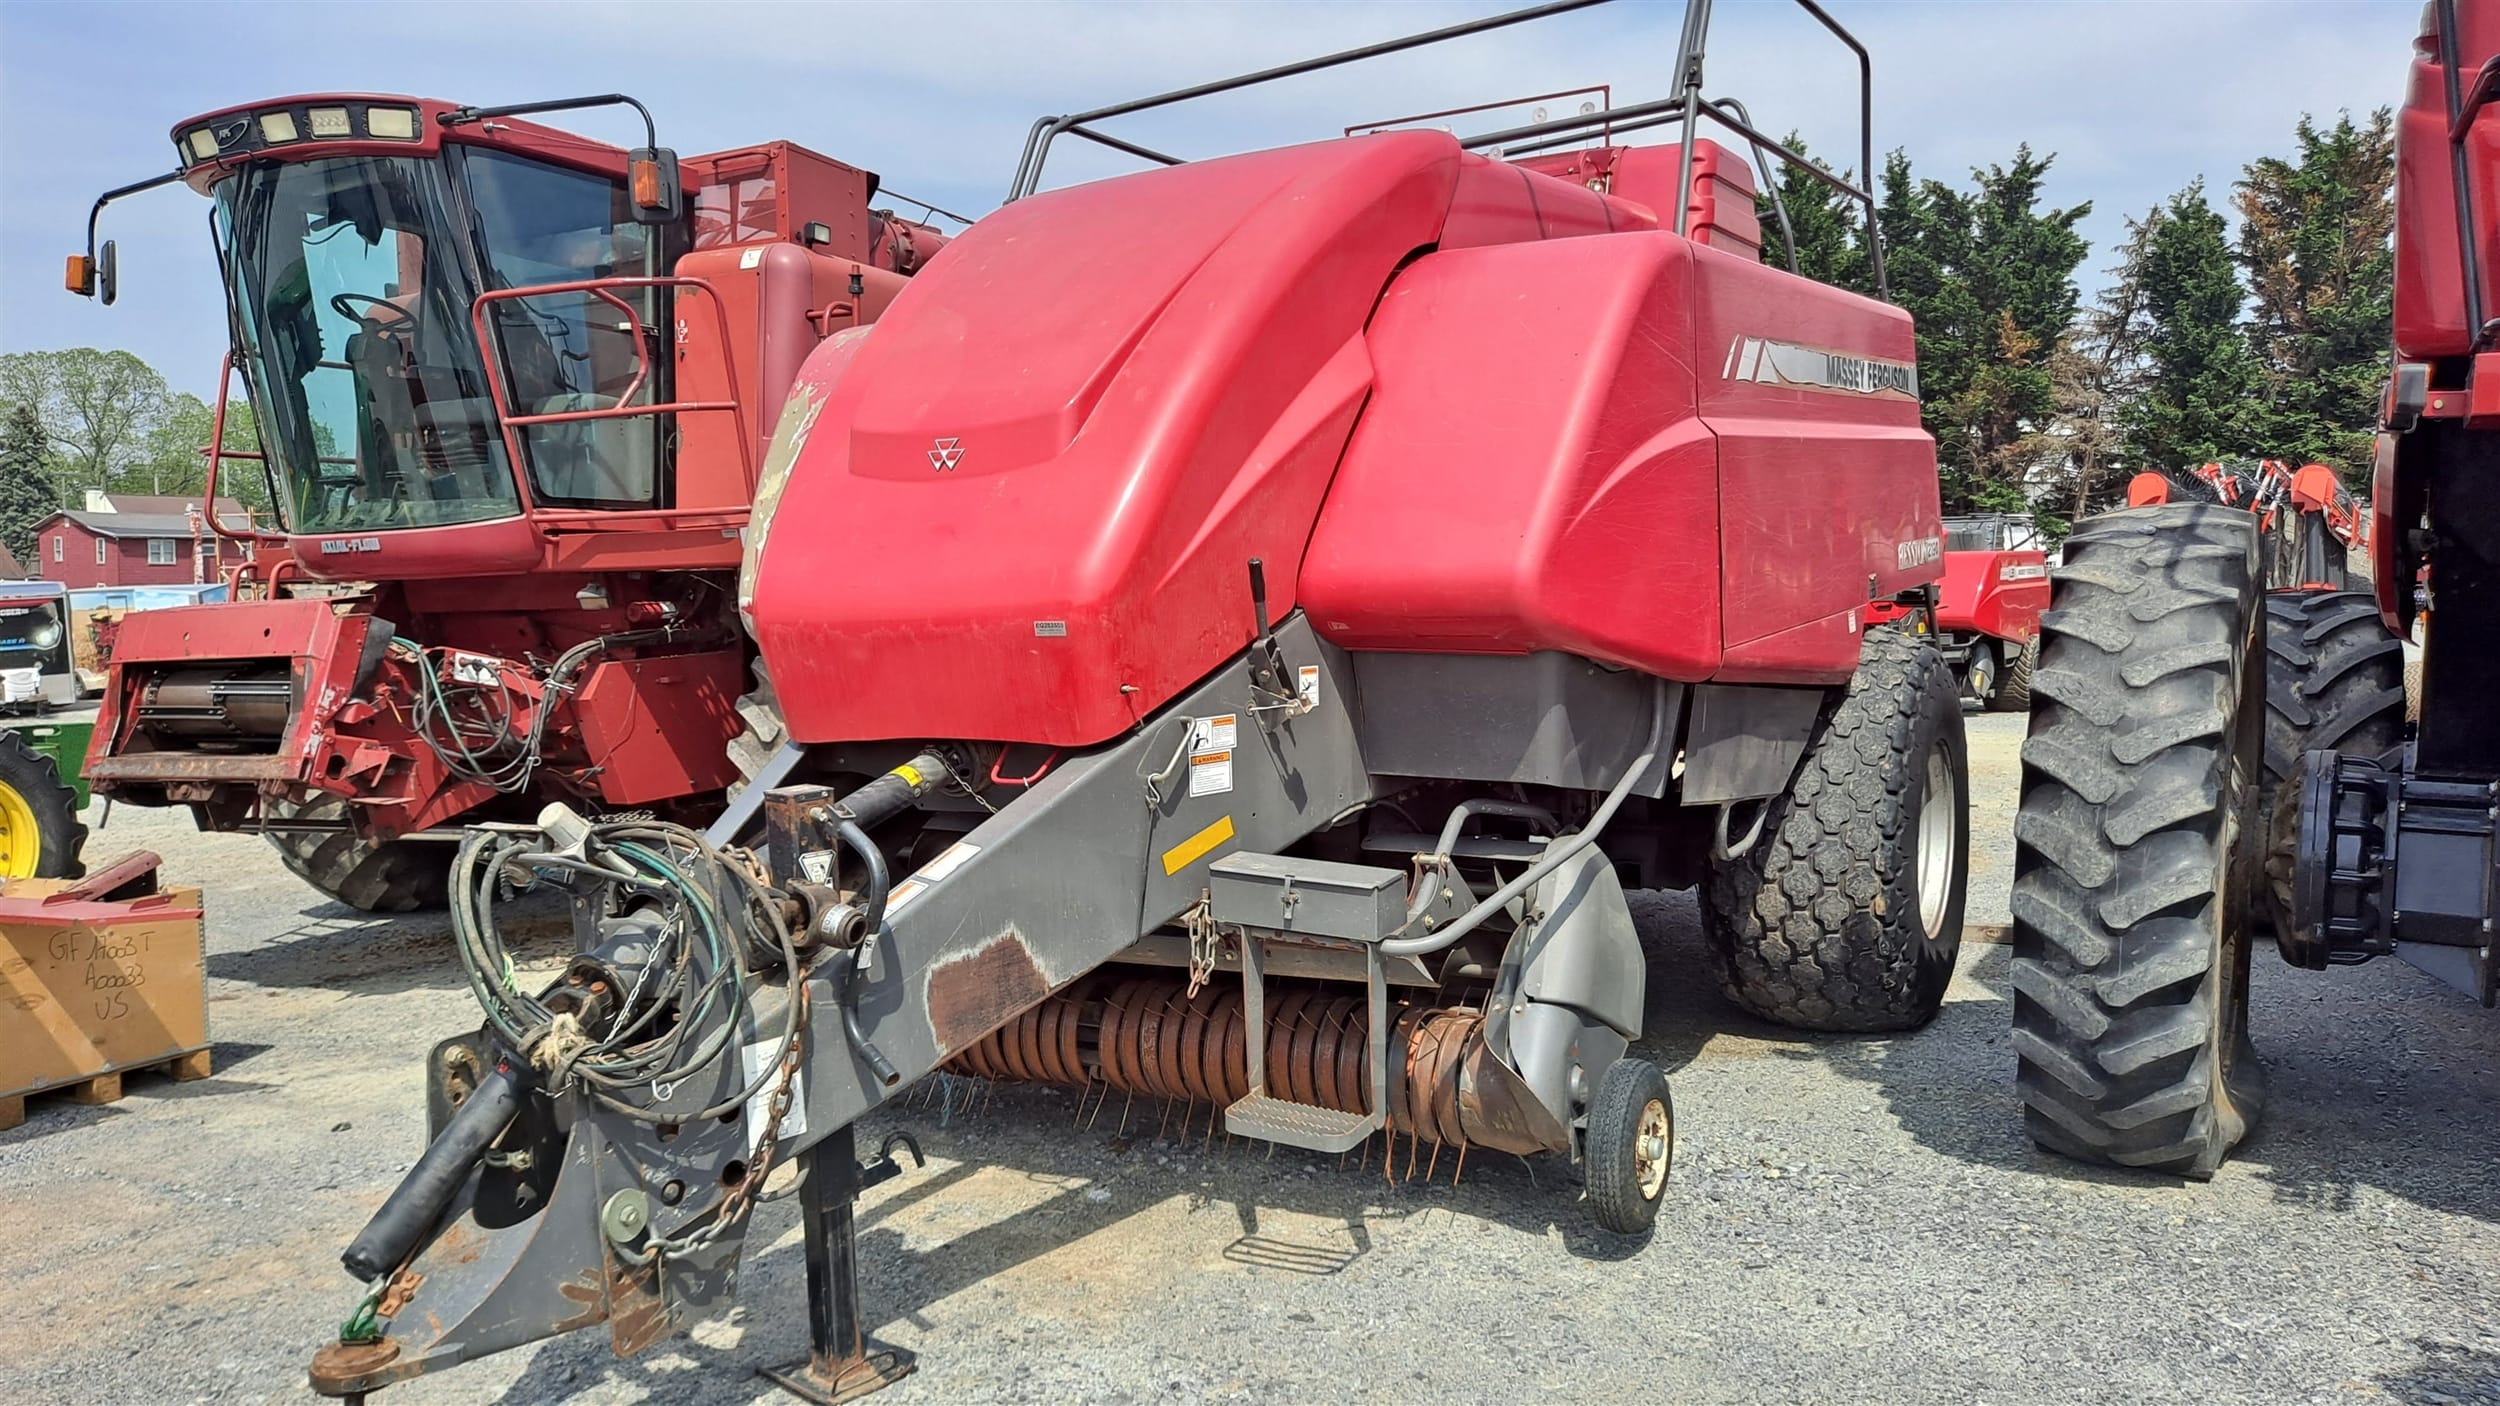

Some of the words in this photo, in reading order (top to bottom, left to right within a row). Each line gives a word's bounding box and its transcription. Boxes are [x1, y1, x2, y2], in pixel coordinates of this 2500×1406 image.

[1826, 354, 1865, 389] MASSEY
[1867, 362, 1909, 391] FERGUSON
[321, 537, 381, 553] AXIAL-FLOW
[49, 931, 82, 962] GF
[95, 990, 129, 1020] US
